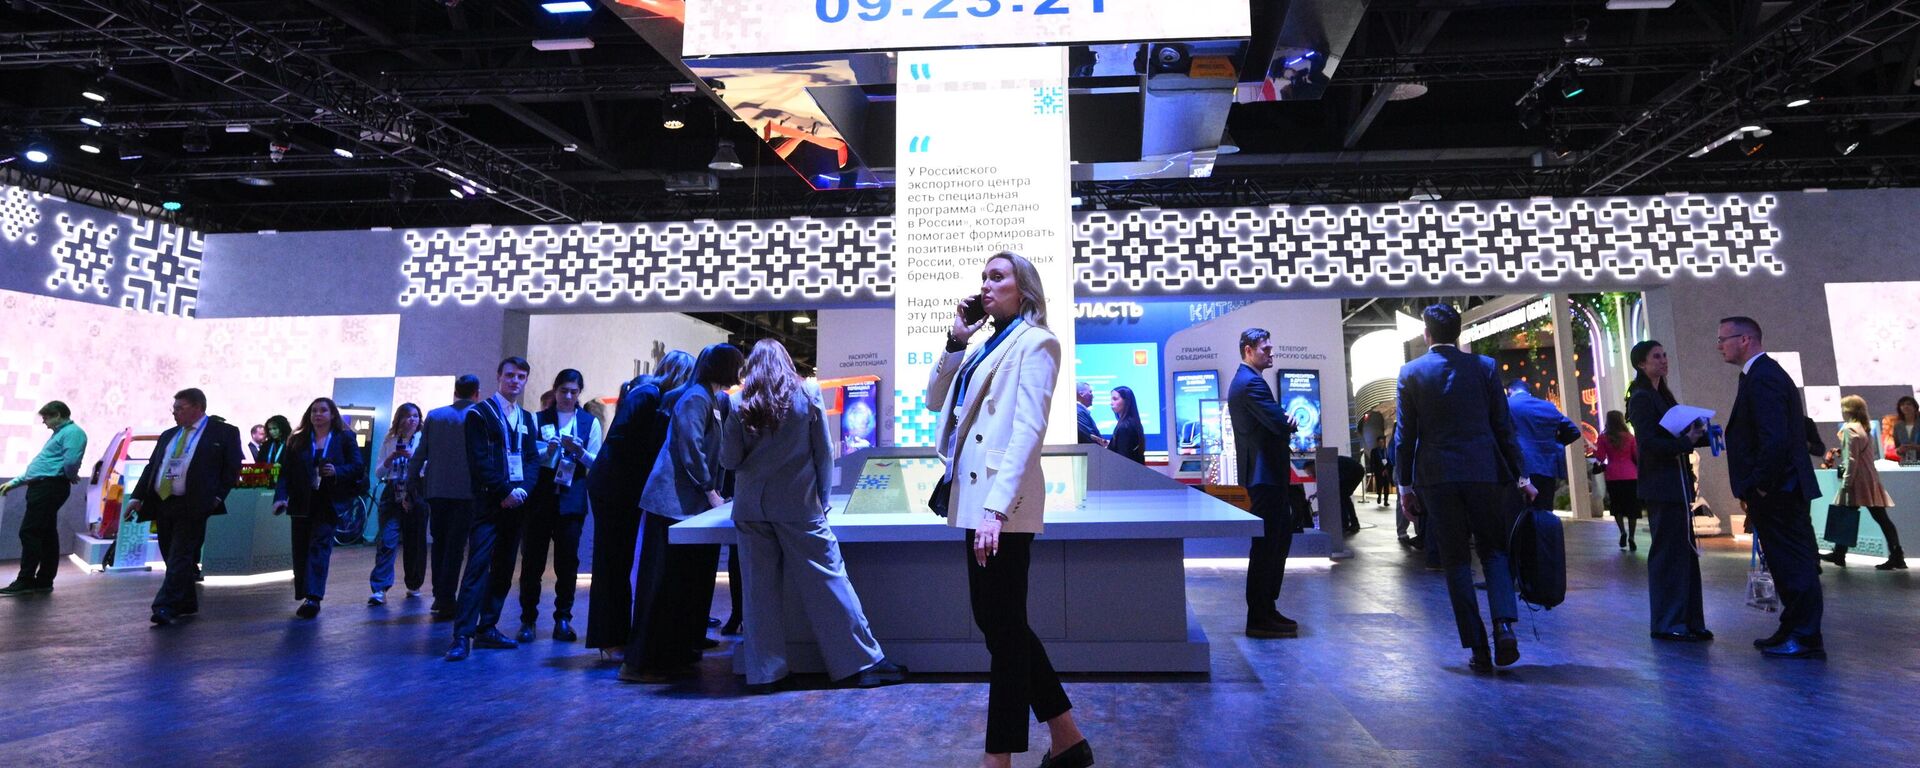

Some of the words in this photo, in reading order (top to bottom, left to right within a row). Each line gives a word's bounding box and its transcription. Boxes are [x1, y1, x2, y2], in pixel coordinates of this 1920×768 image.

[908, 167, 916, 177] У
[919, 166, 998, 177] Российского
[908, 179, 985, 190] экспортного
[987, 178, 1031, 188] центра
[908, 192, 935, 202] есть
[938, 191, 1019, 202] специальная
[908, 205, 977, 216] программа
[980, 203, 1040, 213] «Сделано
[908, 219, 915, 228] в
[975, 217, 1025, 227] которая
[908, 231, 965, 241] помогает
[968, 229, 1055, 241] формировать
[908, 242, 984, 254] позитивный
[987, 241, 1024, 253] образ
[908, 257, 955, 267] России,
[908, 296, 940, 308] Надо
[908, 312, 927, 322] эту
[1181, 346, 1212, 354] ГРАНИЦА
[848, 352, 878, 360] РАСКРОЙТЕ
[1175, 353, 1219, 361] ОБЪЕДИНЯЕТ
[839, 360, 854, 368] СВОЙ
[855, 359, 887, 367] ПОТЕНЦИАЛ
